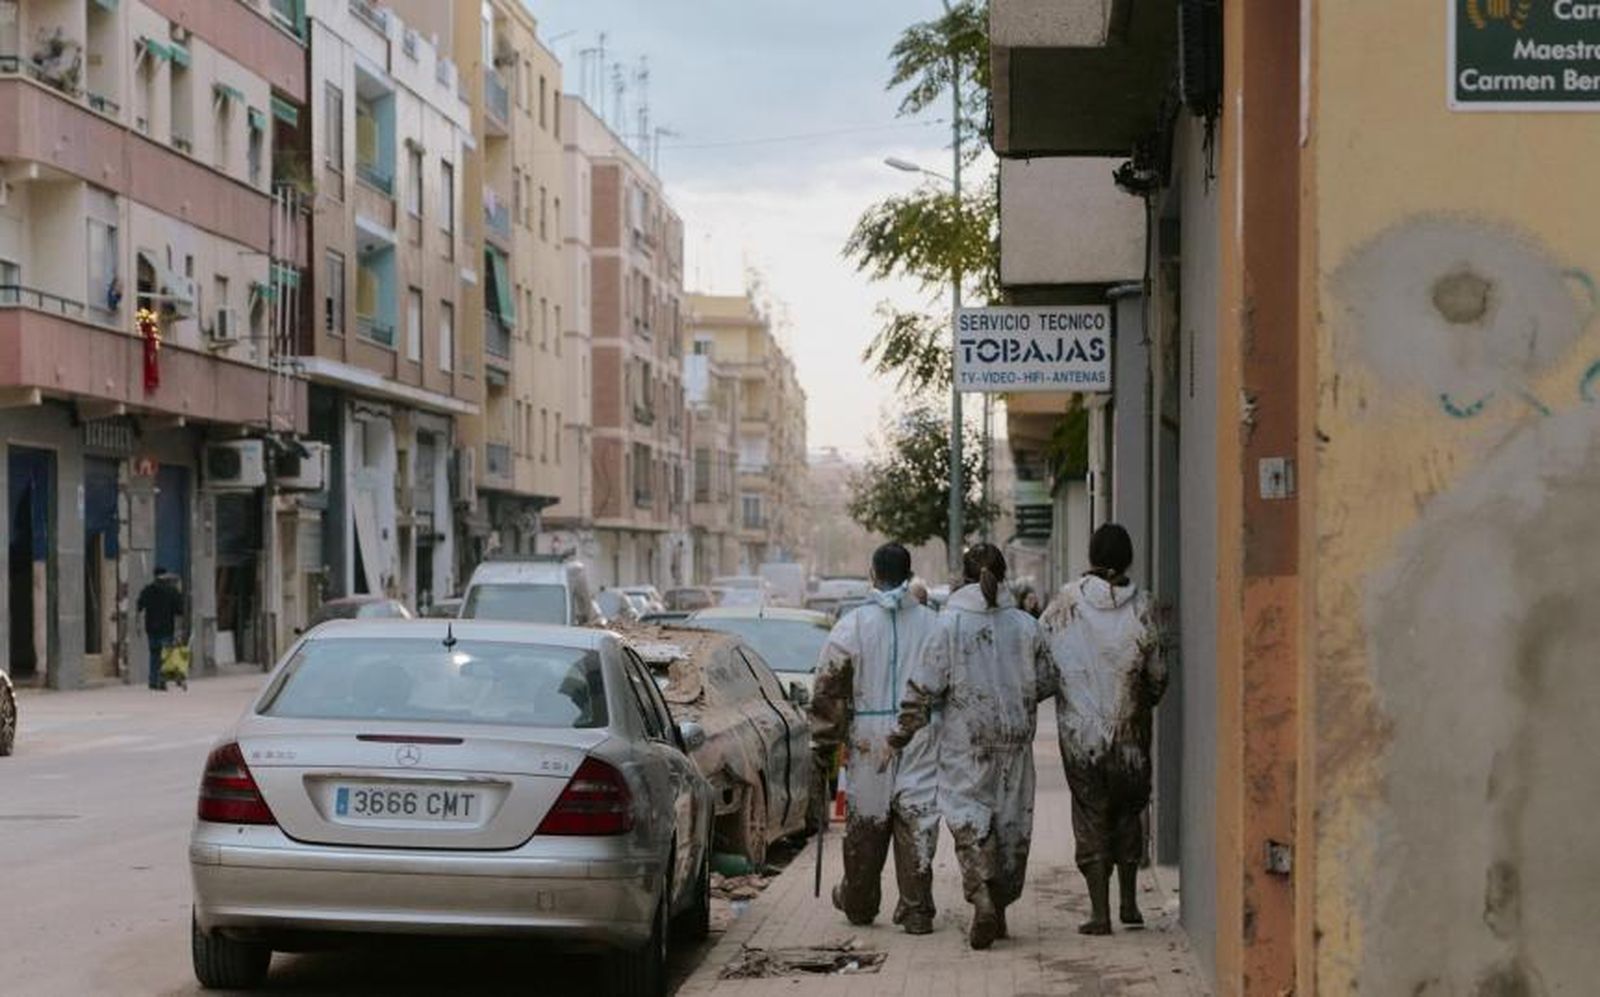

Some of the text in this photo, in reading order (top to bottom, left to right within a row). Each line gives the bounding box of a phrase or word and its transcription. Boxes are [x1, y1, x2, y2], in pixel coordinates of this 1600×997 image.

[1459, 68, 1555, 91] Carmen
[959, 313, 1105, 331] SERVICIO TECNICO
[960, 338, 1105, 363] TOBAJAS
[355, 790, 475, 819] 3666 CMT
